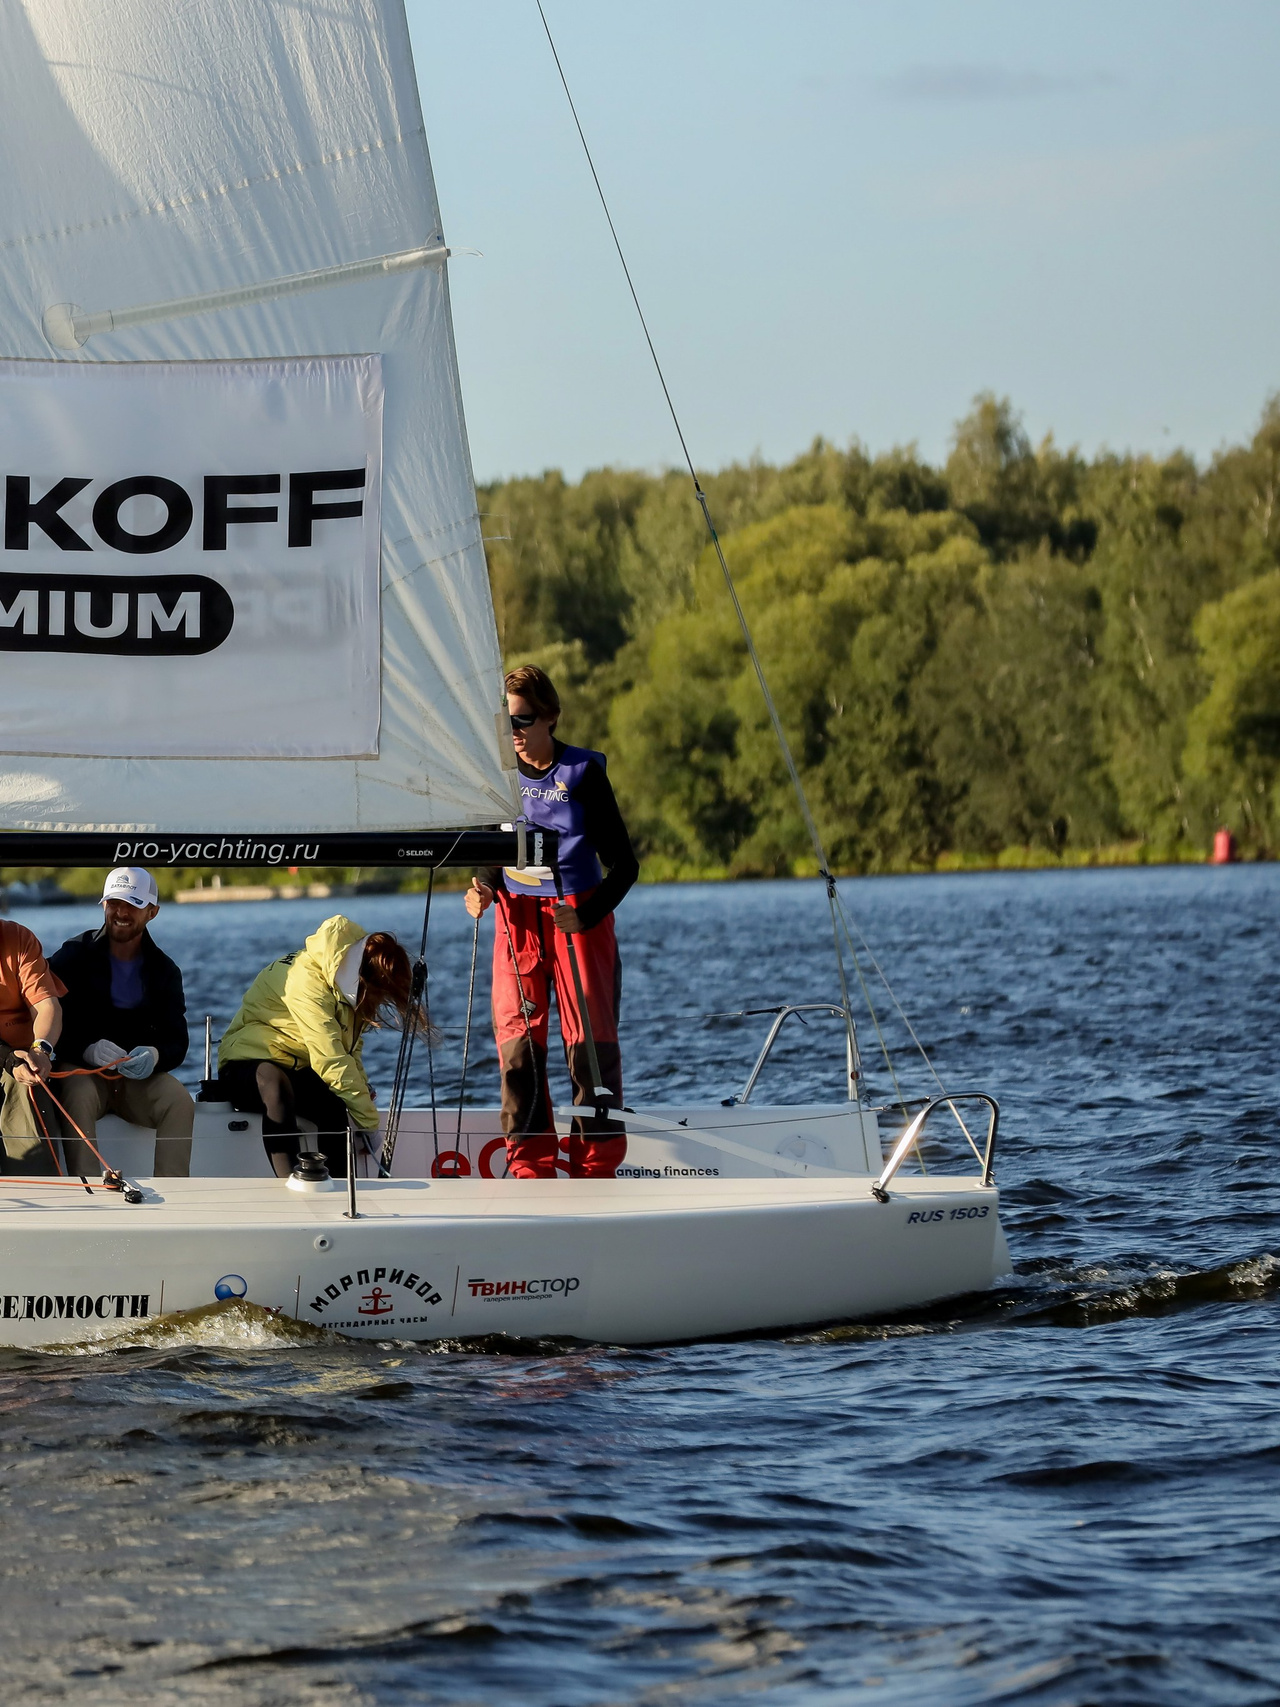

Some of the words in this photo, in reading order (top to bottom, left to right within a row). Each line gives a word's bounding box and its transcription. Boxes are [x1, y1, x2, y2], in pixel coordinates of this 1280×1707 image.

[113, 838, 320, 864] pro-yachting.ru
[664, 1166, 719, 1176] finances
[907, 1209, 945, 1225] RUS
[949, 1205, 990, 1220] 1503
[309, 1267, 443, 1313] МОРПРИБОР
[321, 1318, 395, 1329] ЛЕГЕНДАРНЫЕ
[400, 1316, 428, 1324] ЧАСЫ
